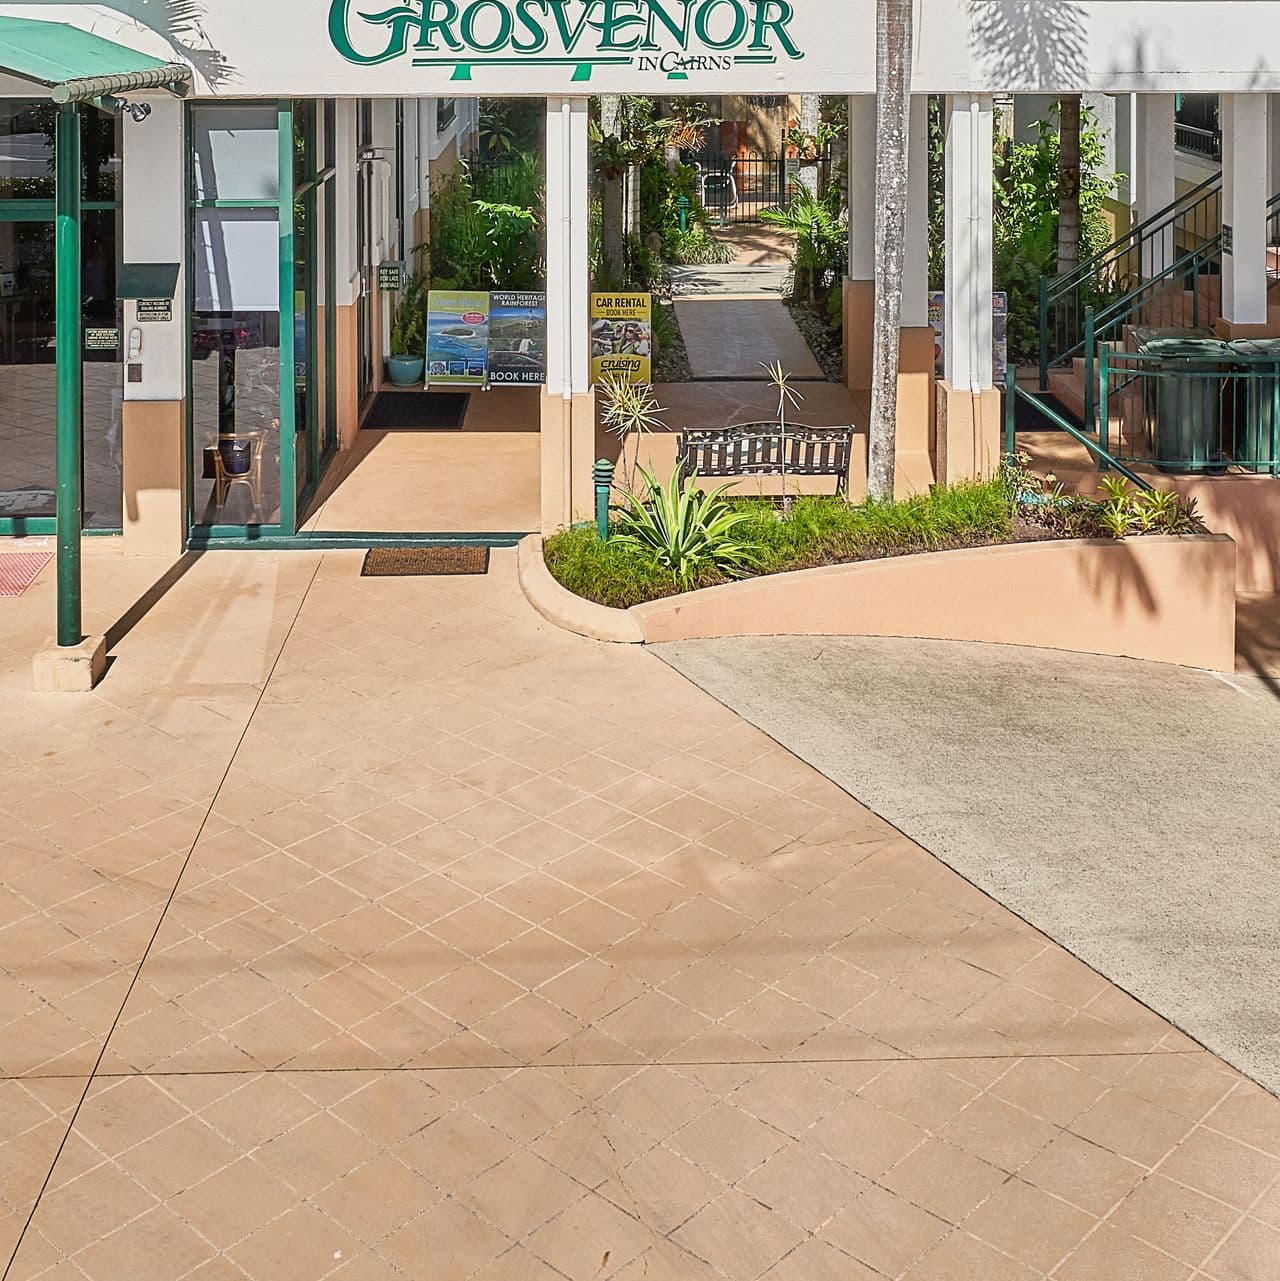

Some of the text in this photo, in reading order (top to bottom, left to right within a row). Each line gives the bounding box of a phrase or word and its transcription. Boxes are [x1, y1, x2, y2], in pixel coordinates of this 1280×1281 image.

[638, 51, 732, 72] IN CAIRNS
[596, 298, 646, 308] CAR RENTAL
[606, 308, 636, 316] BOOK HERE
[601, 357, 641, 371] cruising
[490, 372, 545, 381] BOOK HERE
